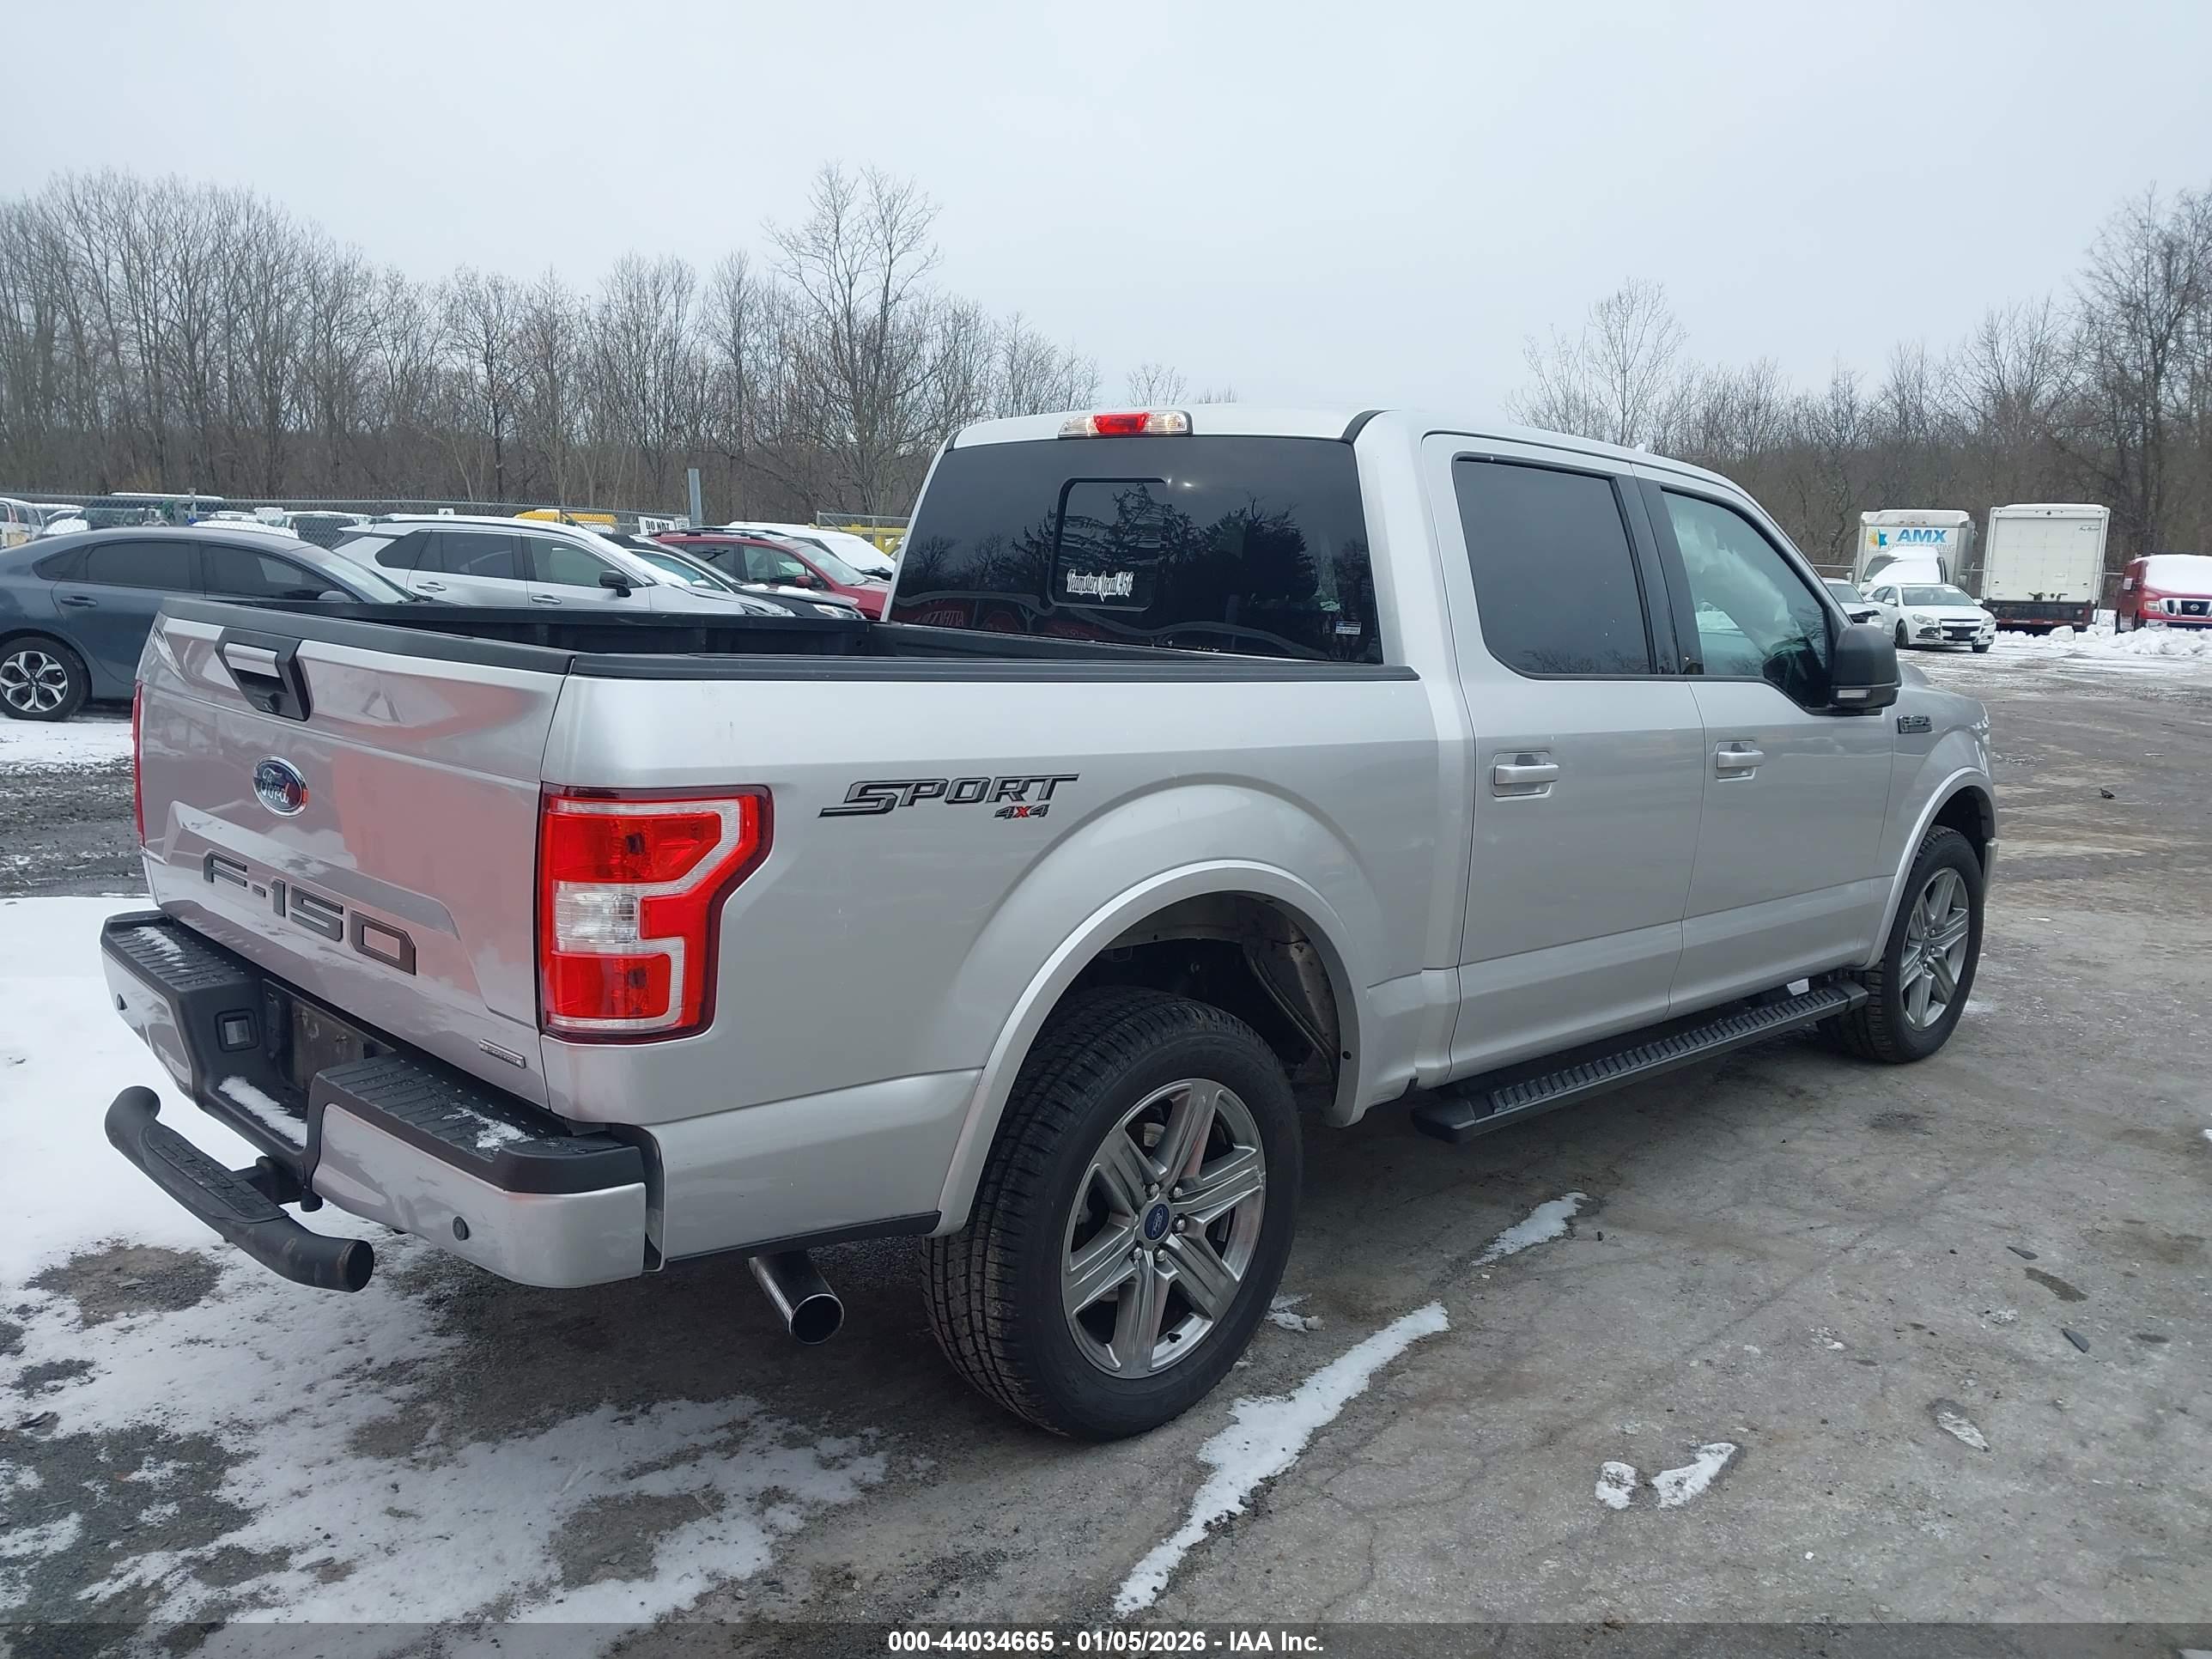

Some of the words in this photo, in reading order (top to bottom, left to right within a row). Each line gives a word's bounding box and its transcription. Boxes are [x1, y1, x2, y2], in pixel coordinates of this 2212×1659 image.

[646, 520, 656, 531] DO
[1897, 529, 1948, 543] AMX
[261, 768, 290, 804] Ford
[817, 774, 1079, 817] SPORT
[203, 849, 417, 976] F-150
